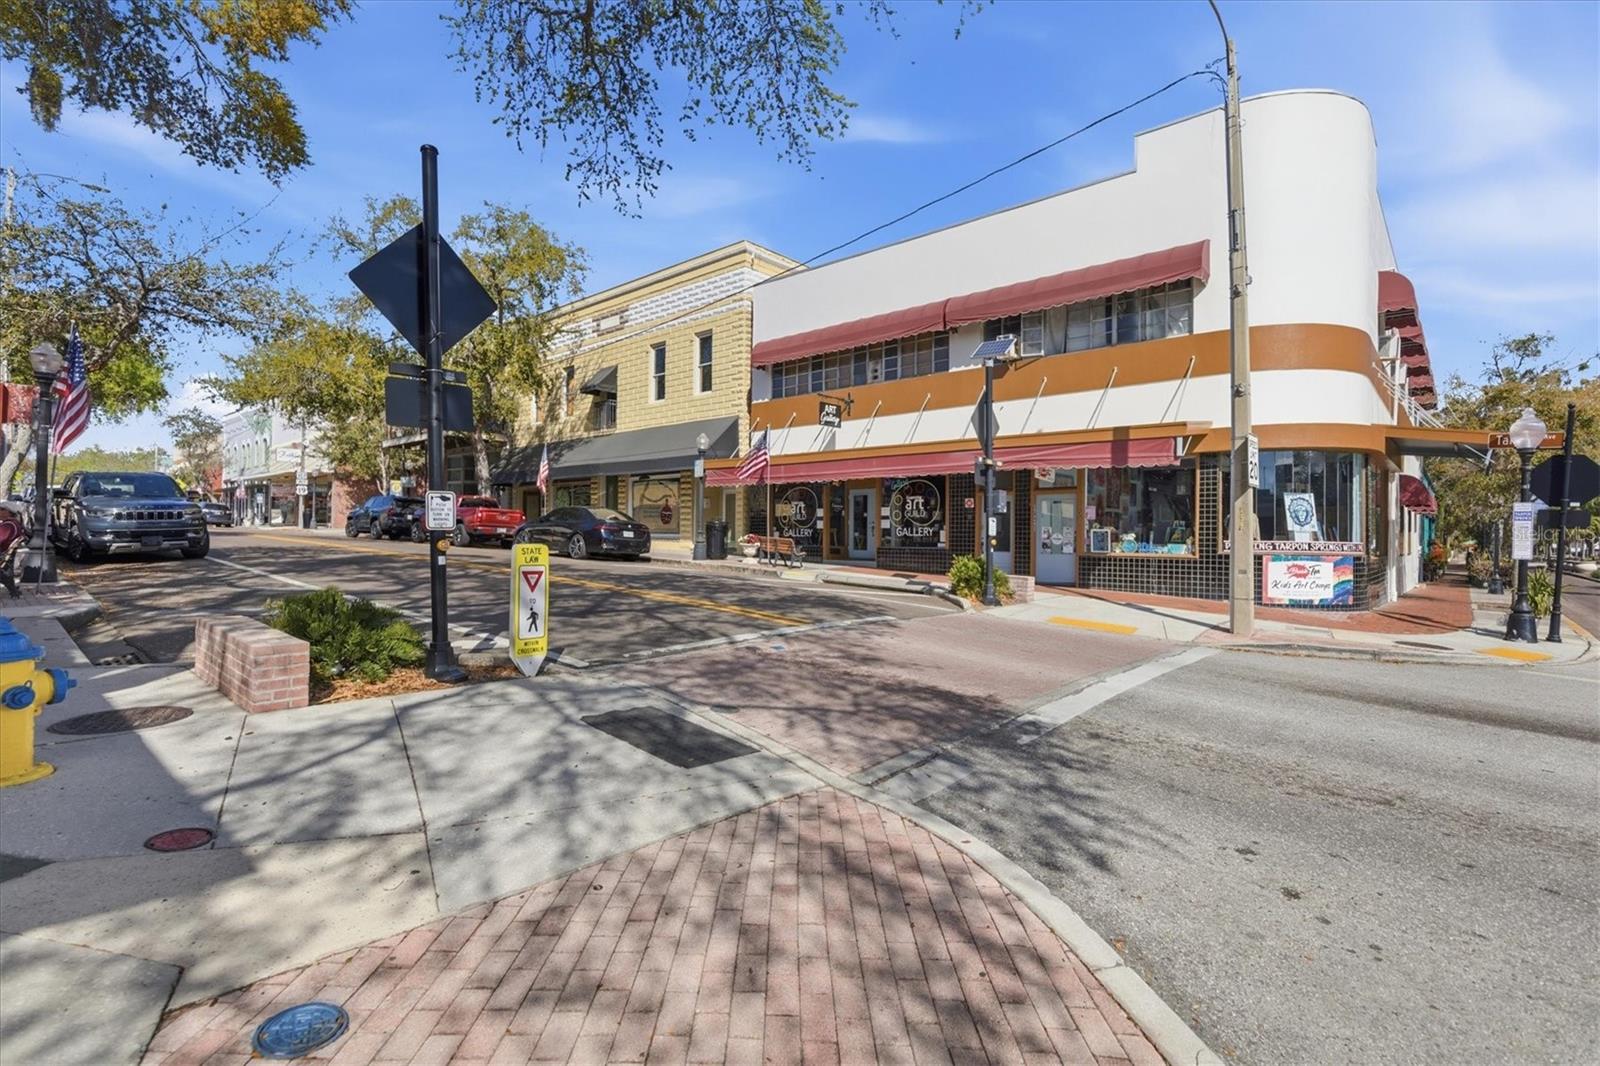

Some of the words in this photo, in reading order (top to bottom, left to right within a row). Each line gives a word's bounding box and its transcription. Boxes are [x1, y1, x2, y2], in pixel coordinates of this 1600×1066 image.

[1250, 460, 1258, 480] 20
[905, 497, 925, 510] art
[783, 528, 813, 537] GALLERY
[896, 526, 934, 537] GALLERY
[521, 547, 541, 555] STATE
[1275, 542, 1309, 551] TARPON
[1310, 542, 1341, 551] SPRINGS
[1271, 579, 1292, 589] Kids
[1293, 580, 1308, 589] Art
